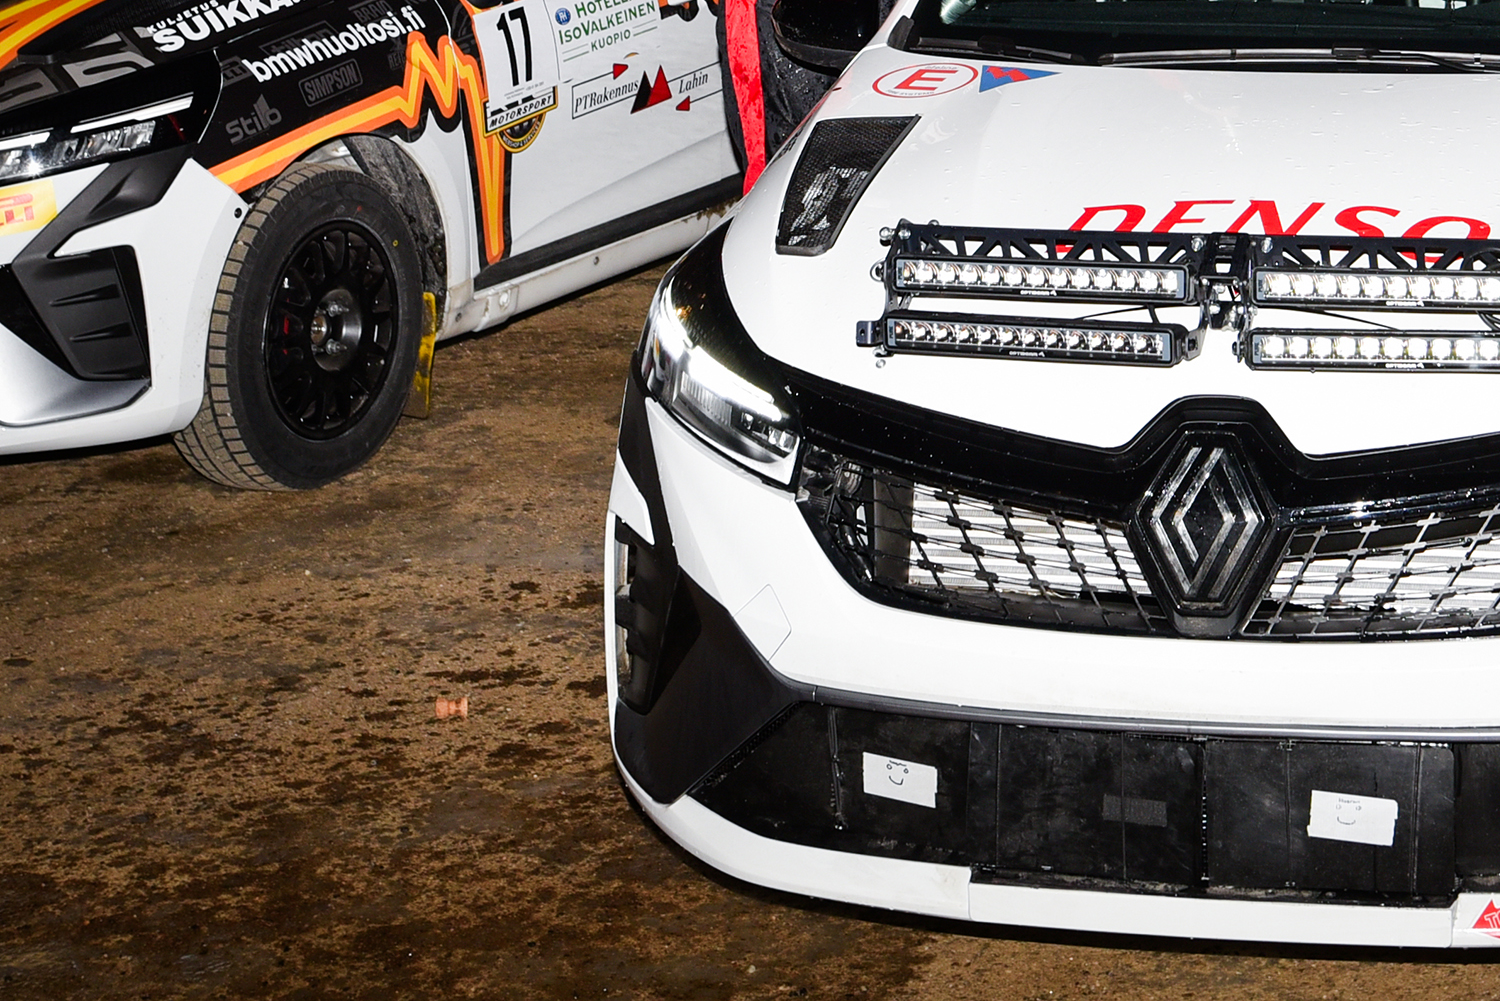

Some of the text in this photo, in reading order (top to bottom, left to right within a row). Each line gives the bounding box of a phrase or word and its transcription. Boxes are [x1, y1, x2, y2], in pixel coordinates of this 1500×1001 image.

[145, 0, 220, 35] KULJETUS
[242, 4, 427, 83] bmwhuoltosi.fi
[496, 5, 533, 88] 17
[590, 29, 632, 53] KUOPIO
[302, 66, 360, 103] SIMPSON
[574, 79, 641, 114] PTRakennus
[678, 72, 710, 95] Lahin
[893, 69, 959, 91] E
[225, 93, 283, 146] Stilo
[488, 95, 553, 129] MOTORSPORT
